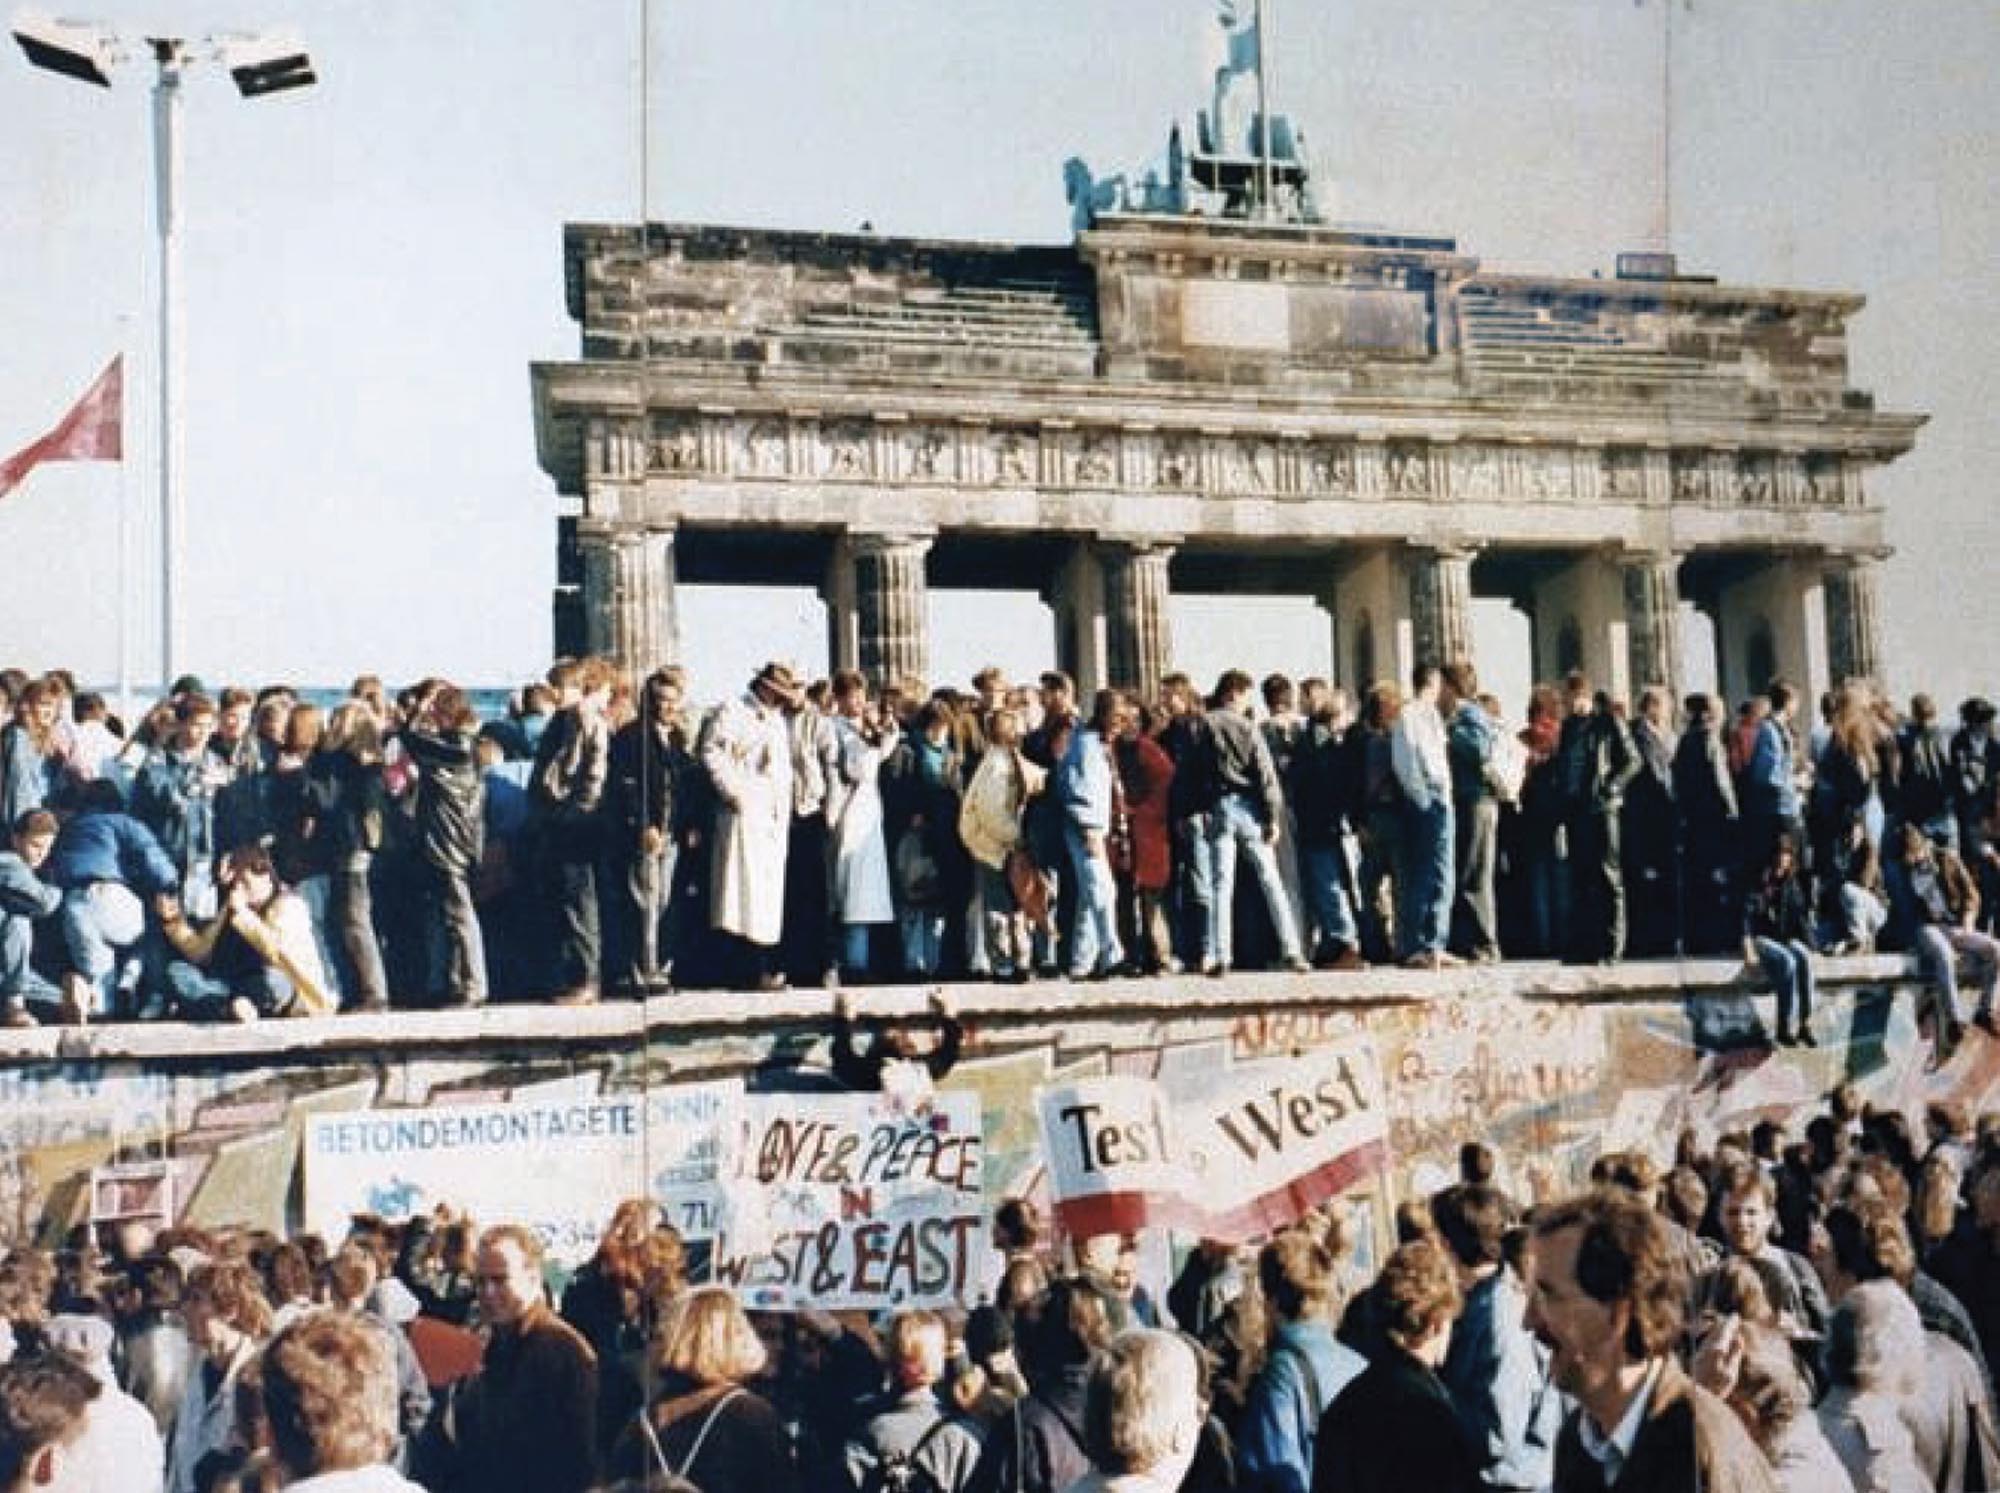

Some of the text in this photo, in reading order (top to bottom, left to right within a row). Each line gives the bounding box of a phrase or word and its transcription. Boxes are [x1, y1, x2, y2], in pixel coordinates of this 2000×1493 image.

[1060, 1101, 1169, 1173] Test
[1215, 1056, 1368, 1163] West
[852, 1214, 982, 1300] EAST
